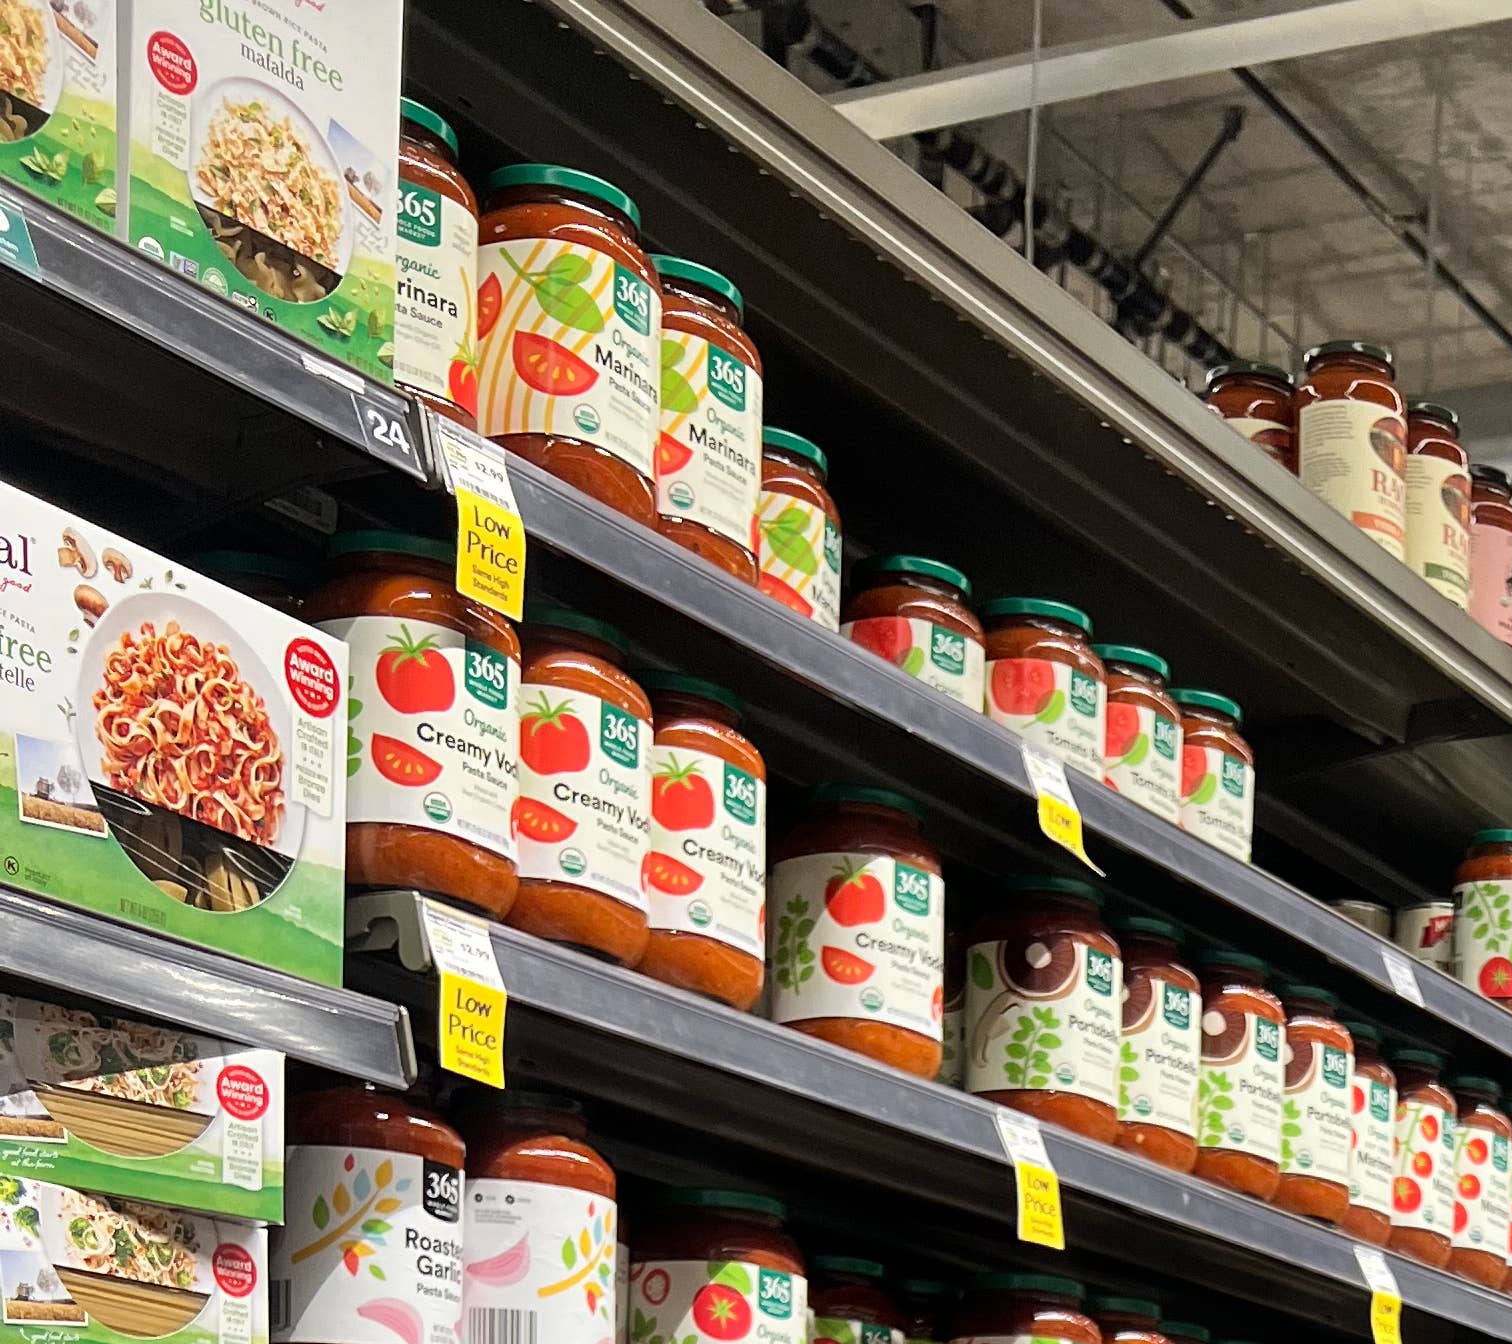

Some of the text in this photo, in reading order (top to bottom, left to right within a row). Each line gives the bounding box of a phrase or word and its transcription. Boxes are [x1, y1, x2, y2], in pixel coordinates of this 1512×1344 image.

[151, 53, 192, 84] Winning
[152, 40, 193, 71] Award
[240, 42, 305, 92] mafalda
[292, 39, 344, 92] free
[396, 254, 441, 280] rganic
[397, 278, 458, 319] rinara
[615, 275, 651, 315] 365
[410, 306, 443, 329] Sauce
[594, 344, 660, 405] Marinara
[709, 353, 745, 395] 365
[367, 410, 411, 454] 24
[688, 423, 757, 477] Marinara
[474, 504, 511, 541] Low
[466, 530, 519, 576] Price
[10, 613, 37, 634] PASTA
[931, 630, 966, 664] 365
[290, 653, 335, 684] Award
[468, 651, 505, 691] 365
[289, 671, 335, 701] Winning
[416, 721, 492, 766] Creamy
[603, 713, 638, 751] 365
[553, 782, 625, 825] Creamy
[725, 774, 756, 810] 365
[682, 838, 747, 878] Creamy
[896, 870, 930, 901] 365
[456, 987, 493, 1018] Low
[448, 1014, 498, 1051] Price
[220, 1076, 265, 1096] Award
[221, 1088, 264, 1108] Winning
[425, 1172, 459, 1205] 365
[1026, 1172, 1050, 1190] Low
[1024, 1191, 1057, 1218] Price
[404, 1226, 464, 1260] Roast
[216, 1255, 254, 1276] Award
[216, 1267, 253, 1286] Winning
[760, 1276, 792, 1304] 365
